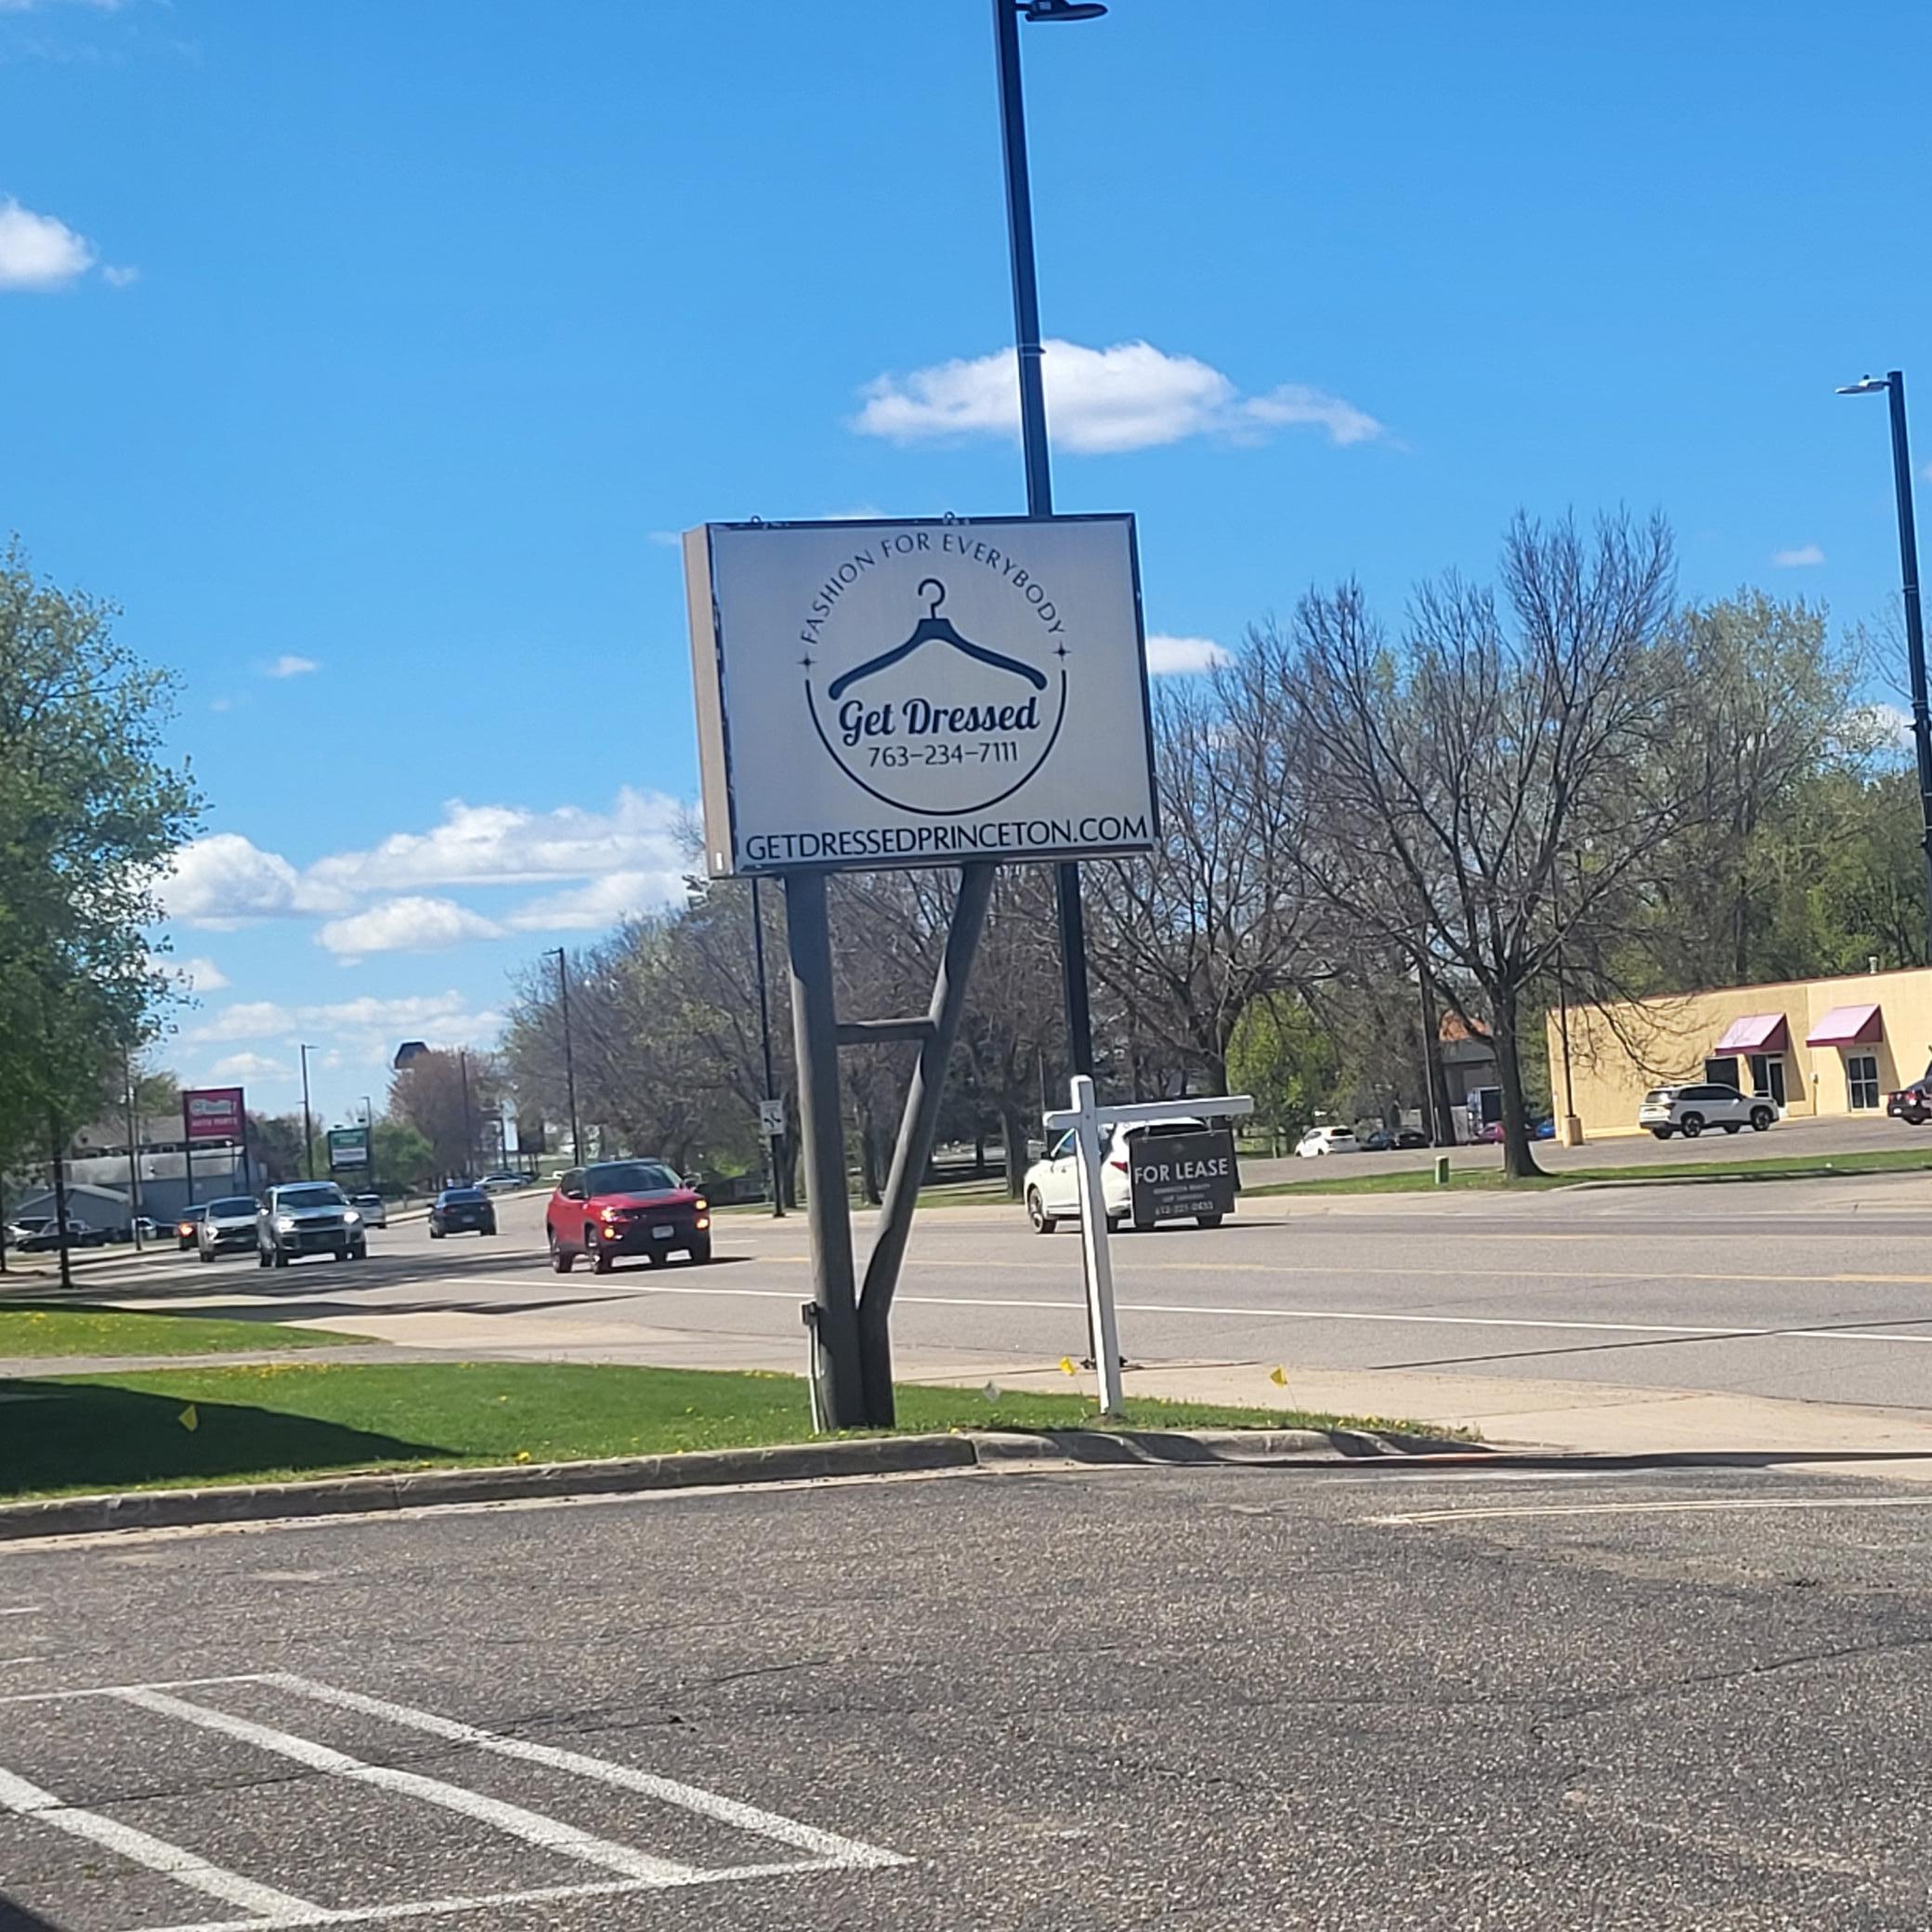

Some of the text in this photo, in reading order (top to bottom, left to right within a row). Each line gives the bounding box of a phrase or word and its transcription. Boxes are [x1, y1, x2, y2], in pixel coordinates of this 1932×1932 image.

[800, 532, 1066, 645] FASHION FOR EVERYBODY
[839, 697, 1041, 747] Get Dressed
[868, 741, 1018, 768] 763-234-7111
[745, 816, 1149, 862] GETDRESSEDPRINCETON.COM
[1134, 1158, 1229, 1185] FOR LEASE
